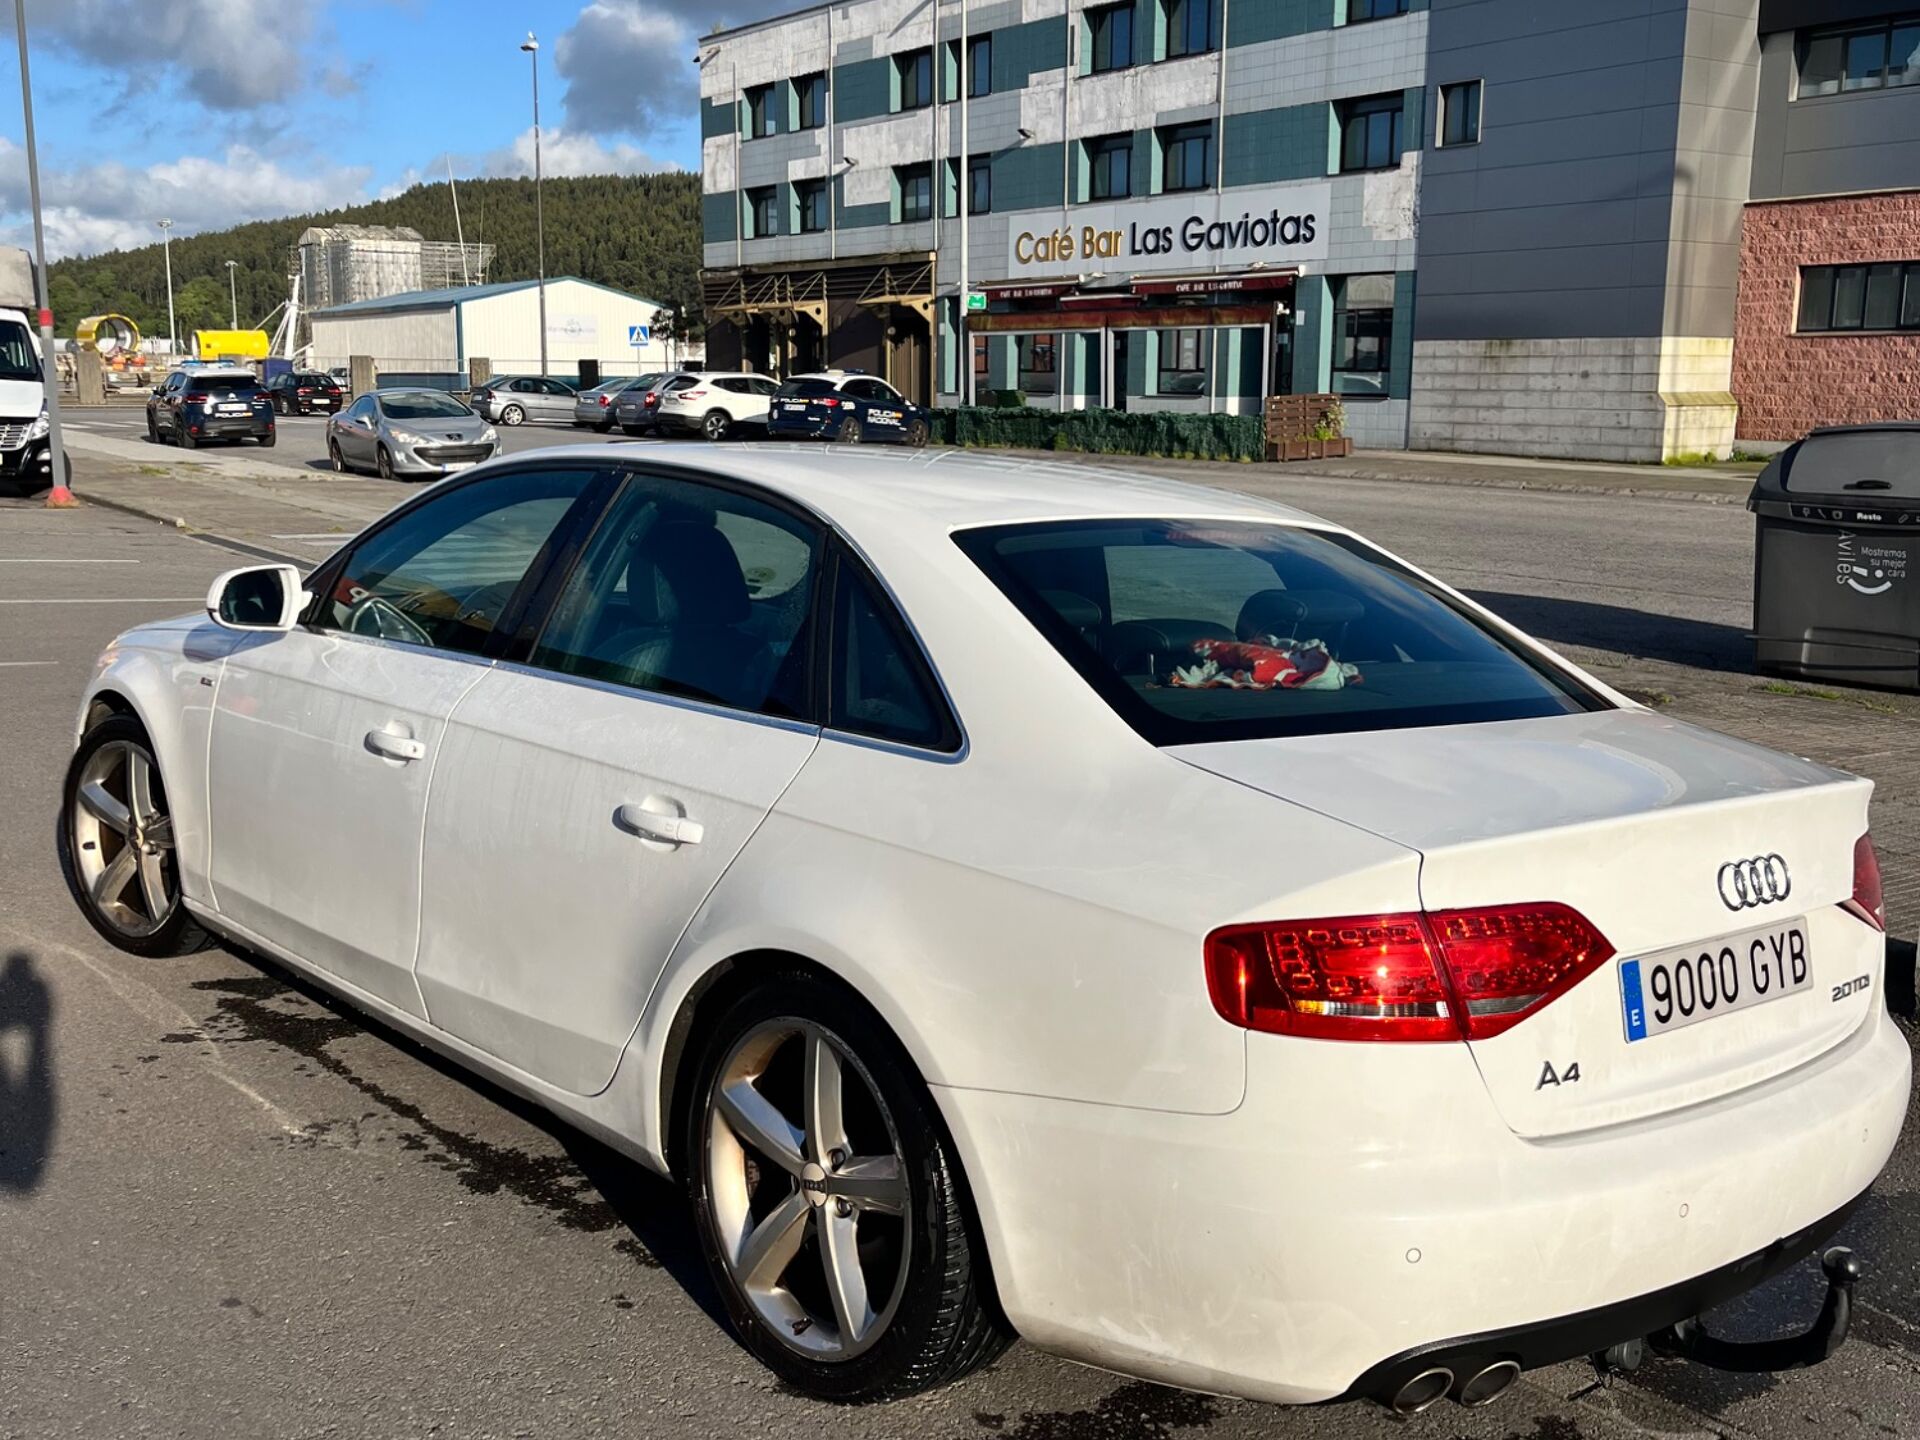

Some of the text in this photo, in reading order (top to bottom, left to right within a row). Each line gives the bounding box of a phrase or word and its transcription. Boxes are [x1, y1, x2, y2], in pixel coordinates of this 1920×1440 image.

[1015, 208, 1317, 265] Café Bar Las Gaviotas
[1857, 512, 1882, 520] Resto
[1861, 546, 1907, 558] Mostremos
[1870, 558, 1907, 569] su mejor
[1887, 569, 1906, 578] cara
[1650, 928, 1808, 1025] 9000 GYB
[1630, 1008, 1641, 1027] E
[1535, 1060, 1581, 1091] A4
